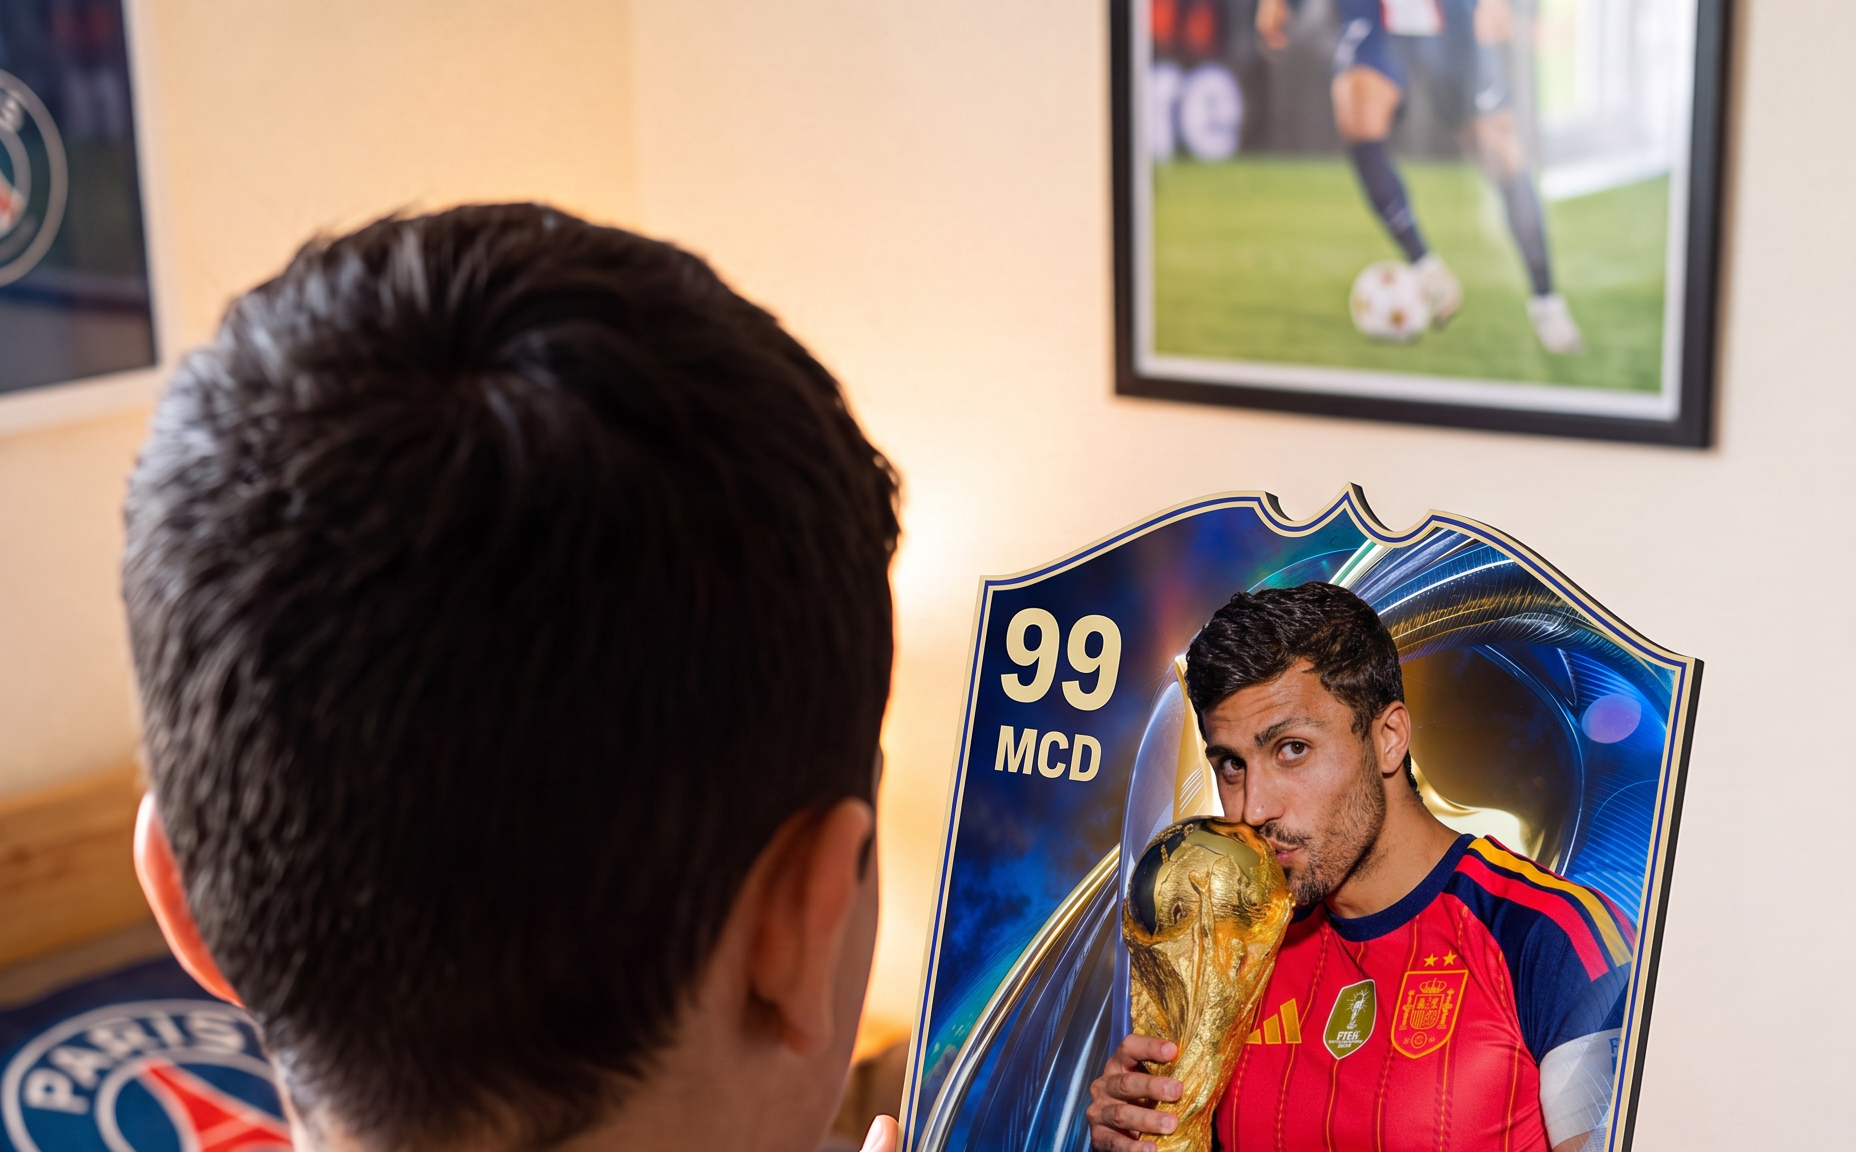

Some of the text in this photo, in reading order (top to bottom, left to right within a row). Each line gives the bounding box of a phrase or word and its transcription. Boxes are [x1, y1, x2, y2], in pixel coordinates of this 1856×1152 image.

[1001, 608, 1121, 711] 99
[994, 725, 1102, 782] MCD
[24, 1011, 247, 1115] PARIS
